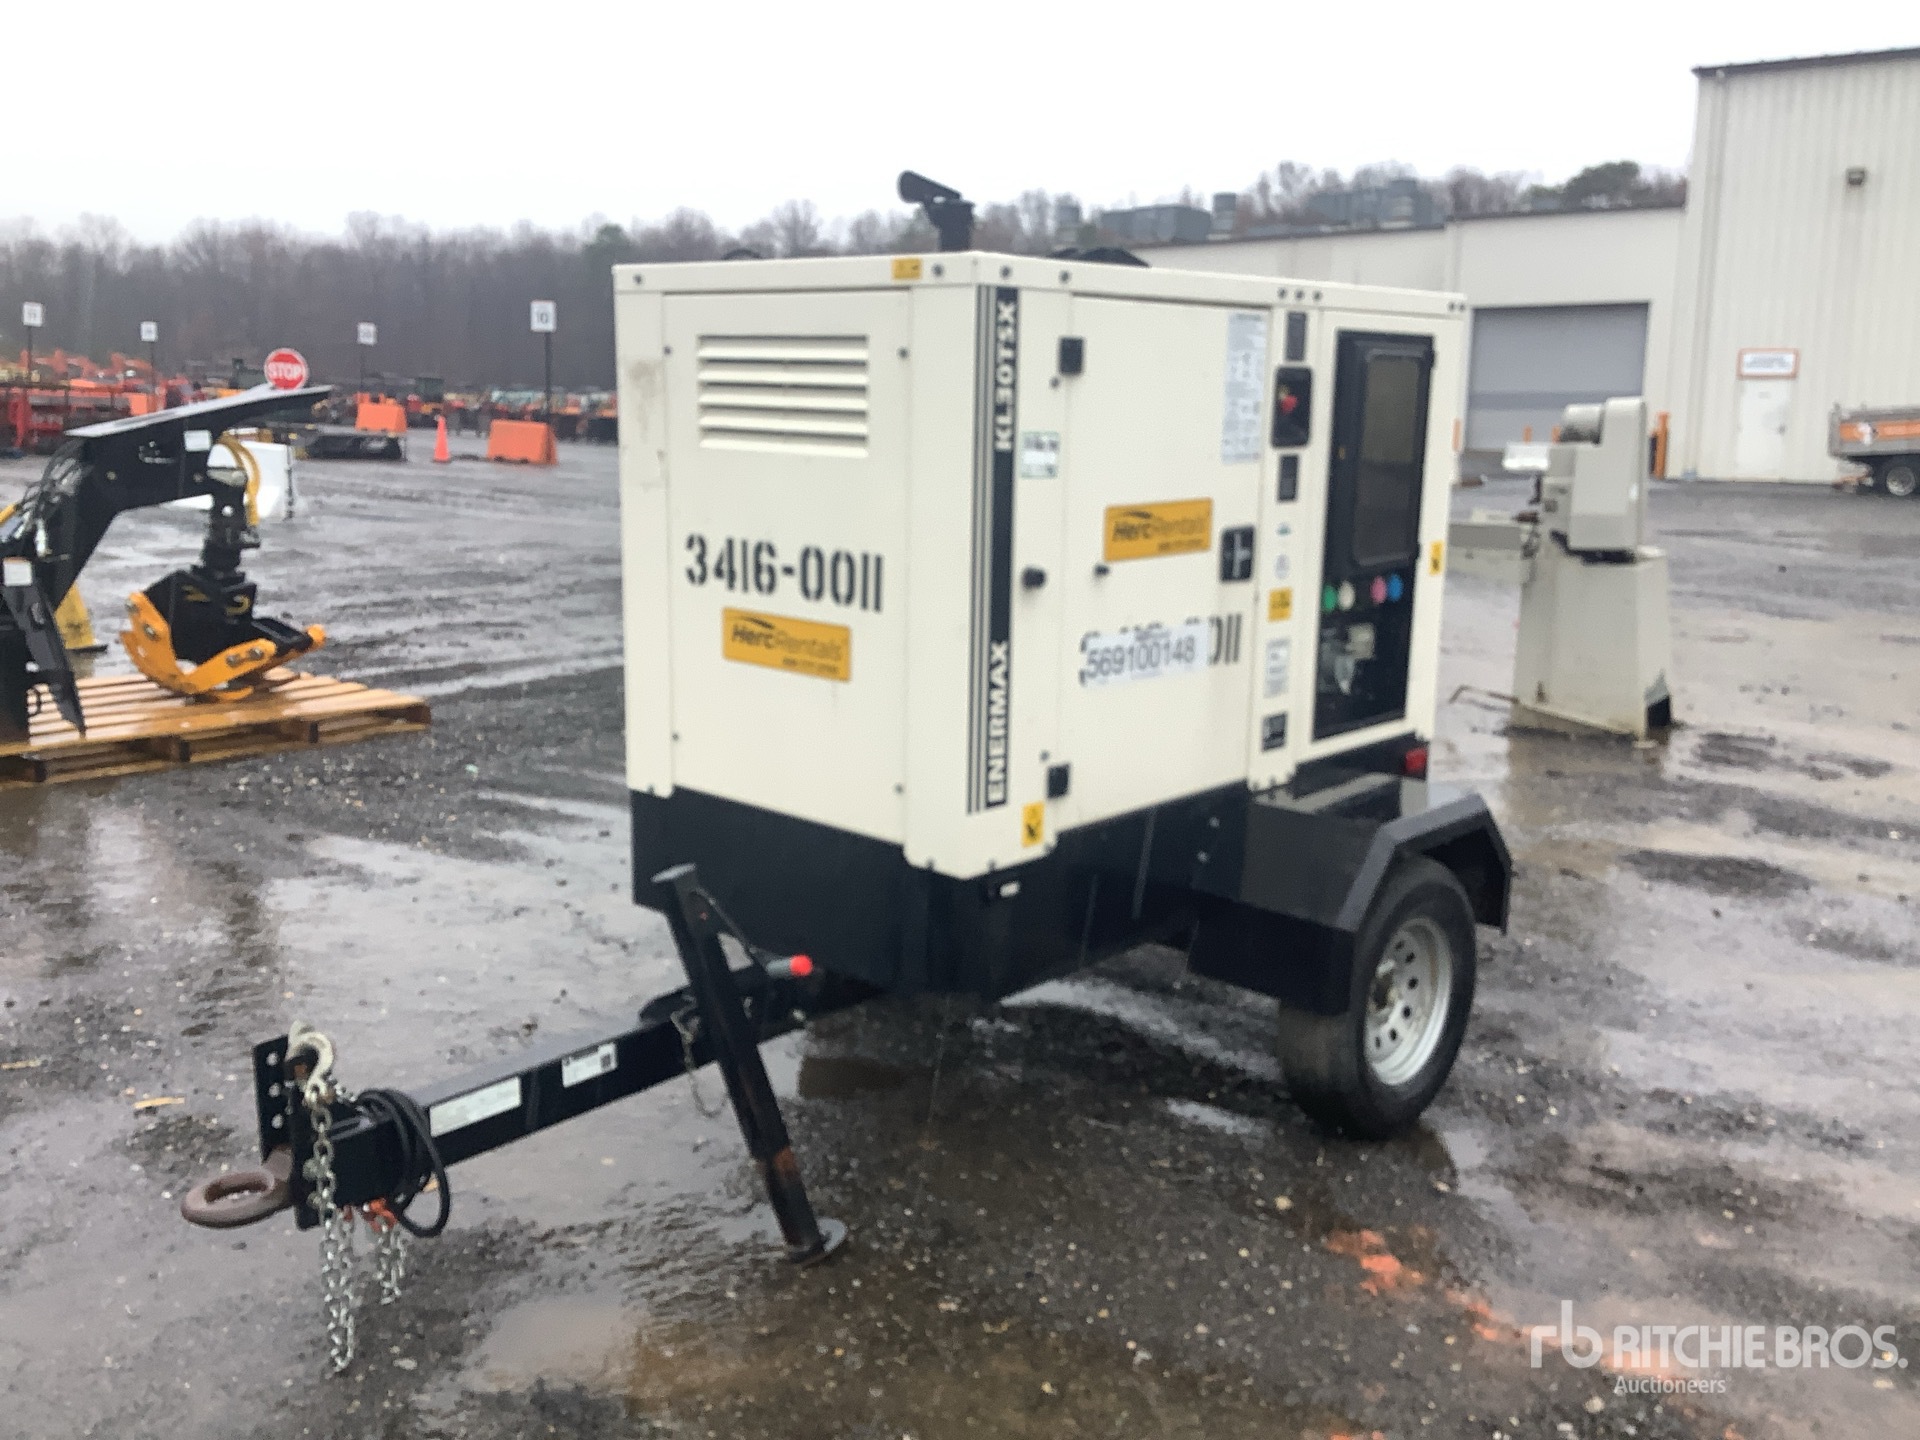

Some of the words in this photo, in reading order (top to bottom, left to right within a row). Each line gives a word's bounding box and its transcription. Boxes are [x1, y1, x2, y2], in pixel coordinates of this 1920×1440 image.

[267, 361, 302, 381] STOP
[685, 533, 885, 613] 3416-0011
[1086, 634, 1196, 679] 569100148
[988, 639, 1009, 803] ENERMAX
